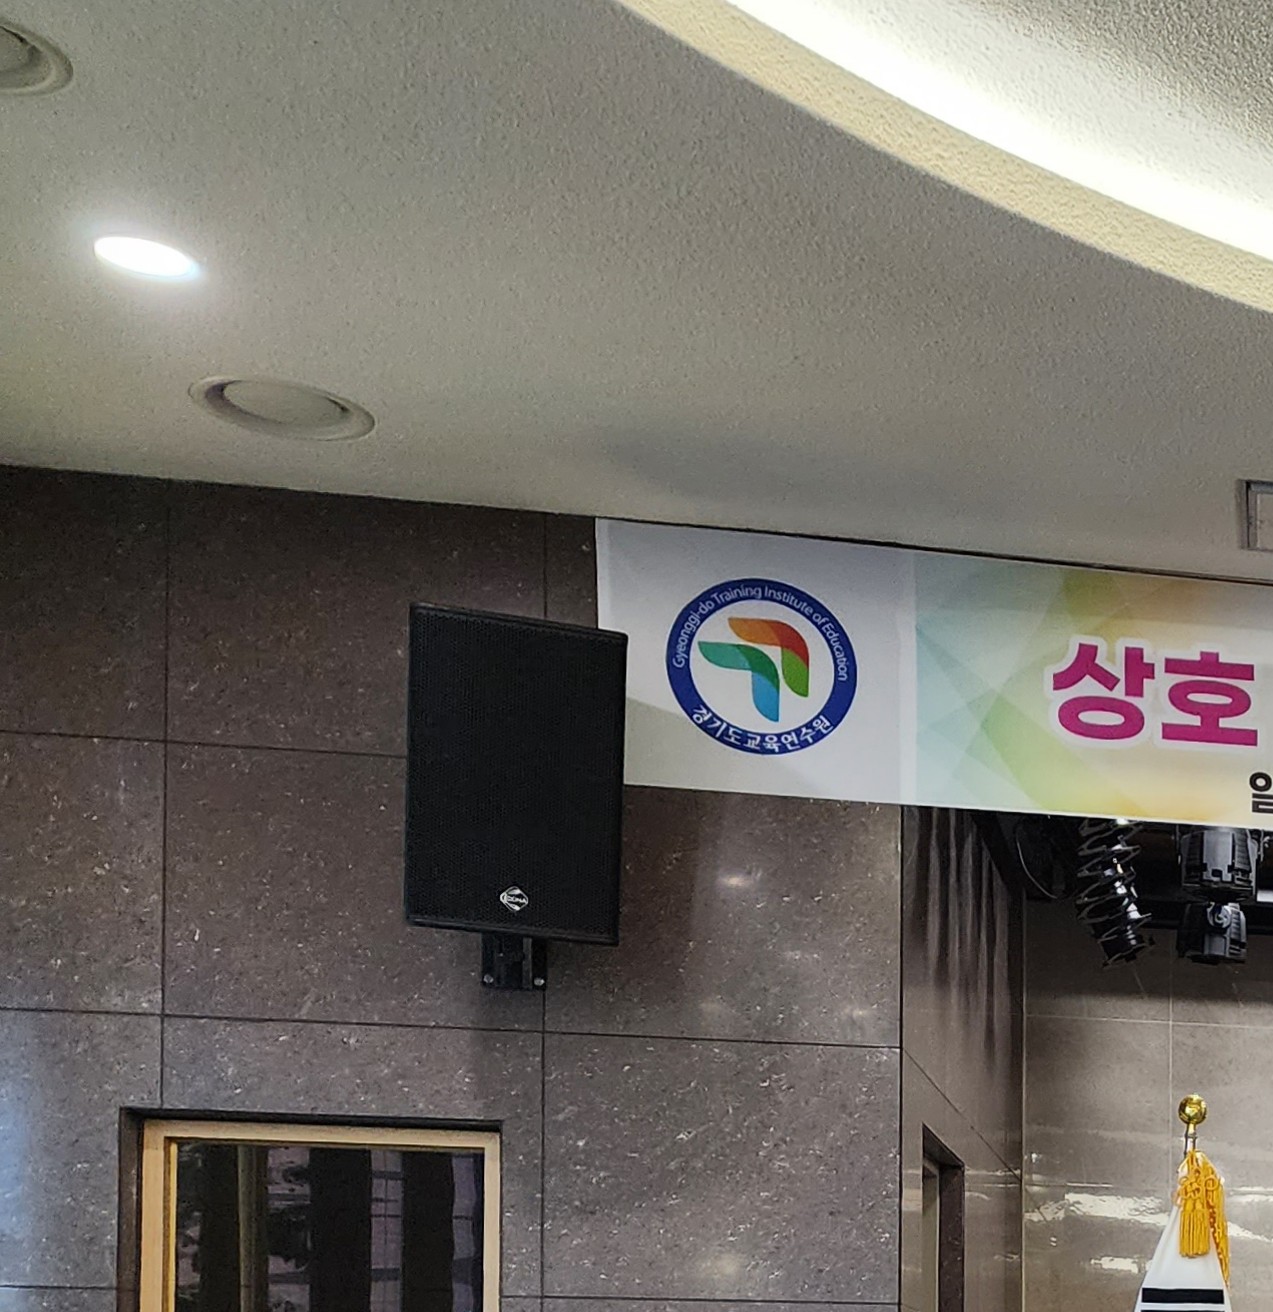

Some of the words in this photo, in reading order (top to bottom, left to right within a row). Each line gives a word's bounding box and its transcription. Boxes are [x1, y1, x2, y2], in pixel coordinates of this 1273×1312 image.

[673, 599, 715, 668] Gyeonggi-do
[711, 583, 763, 605] Training
[764, 585, 814, 616] Institute
[812, 611, 829, 626] of
[821, 623, 848, 681] Education
[692, 704, 834, 752] 경기도교육연수원
[1052, 642, 1259, 748] 상호
